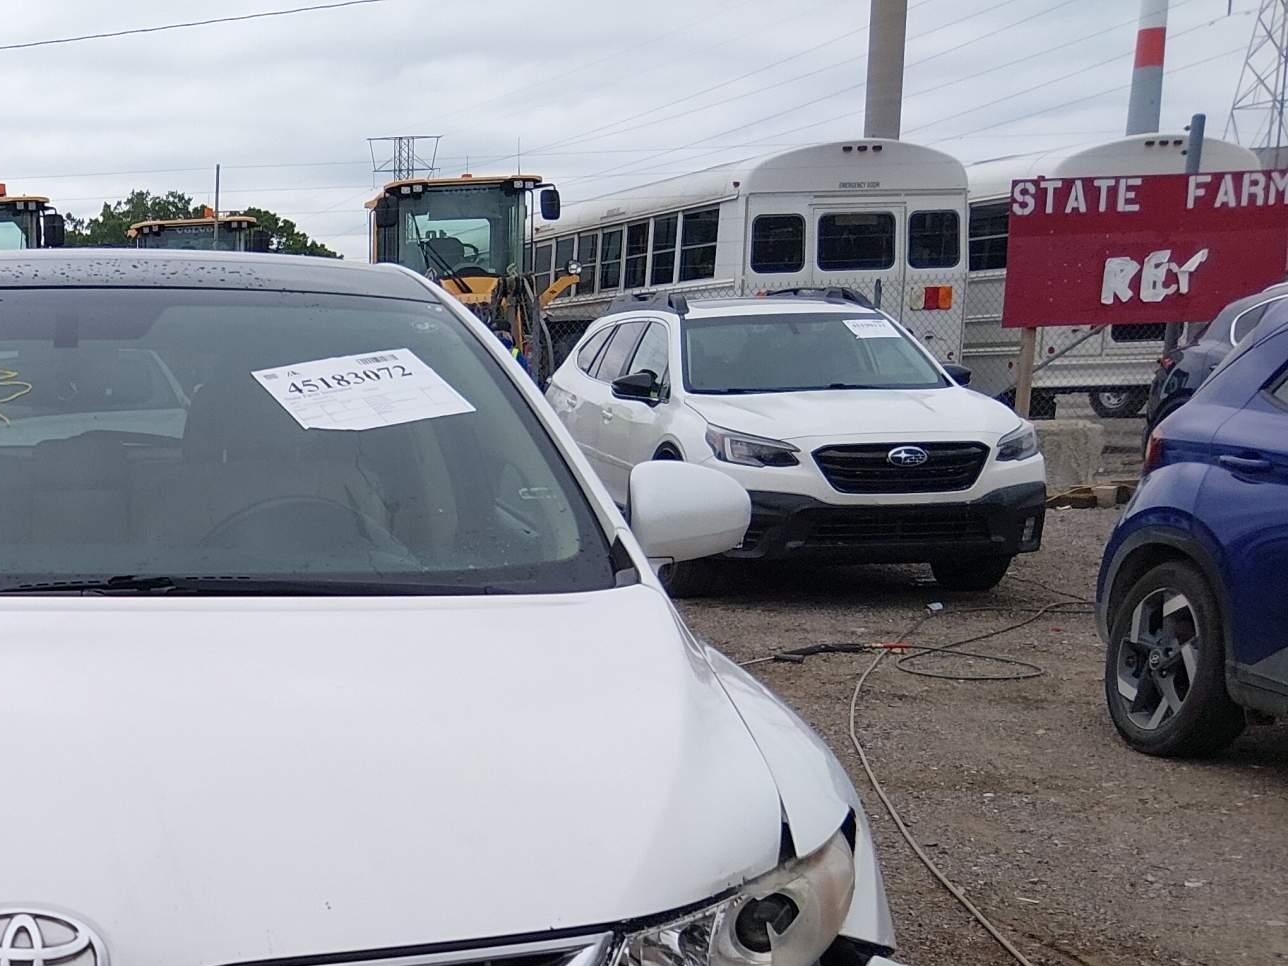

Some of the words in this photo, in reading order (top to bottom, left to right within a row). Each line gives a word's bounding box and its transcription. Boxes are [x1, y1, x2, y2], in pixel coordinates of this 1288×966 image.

[1012, 177, 1143, 216] STATE
[1186, 171, 1288, 209] FARM
[288, 364, 413, 395] 45183072
